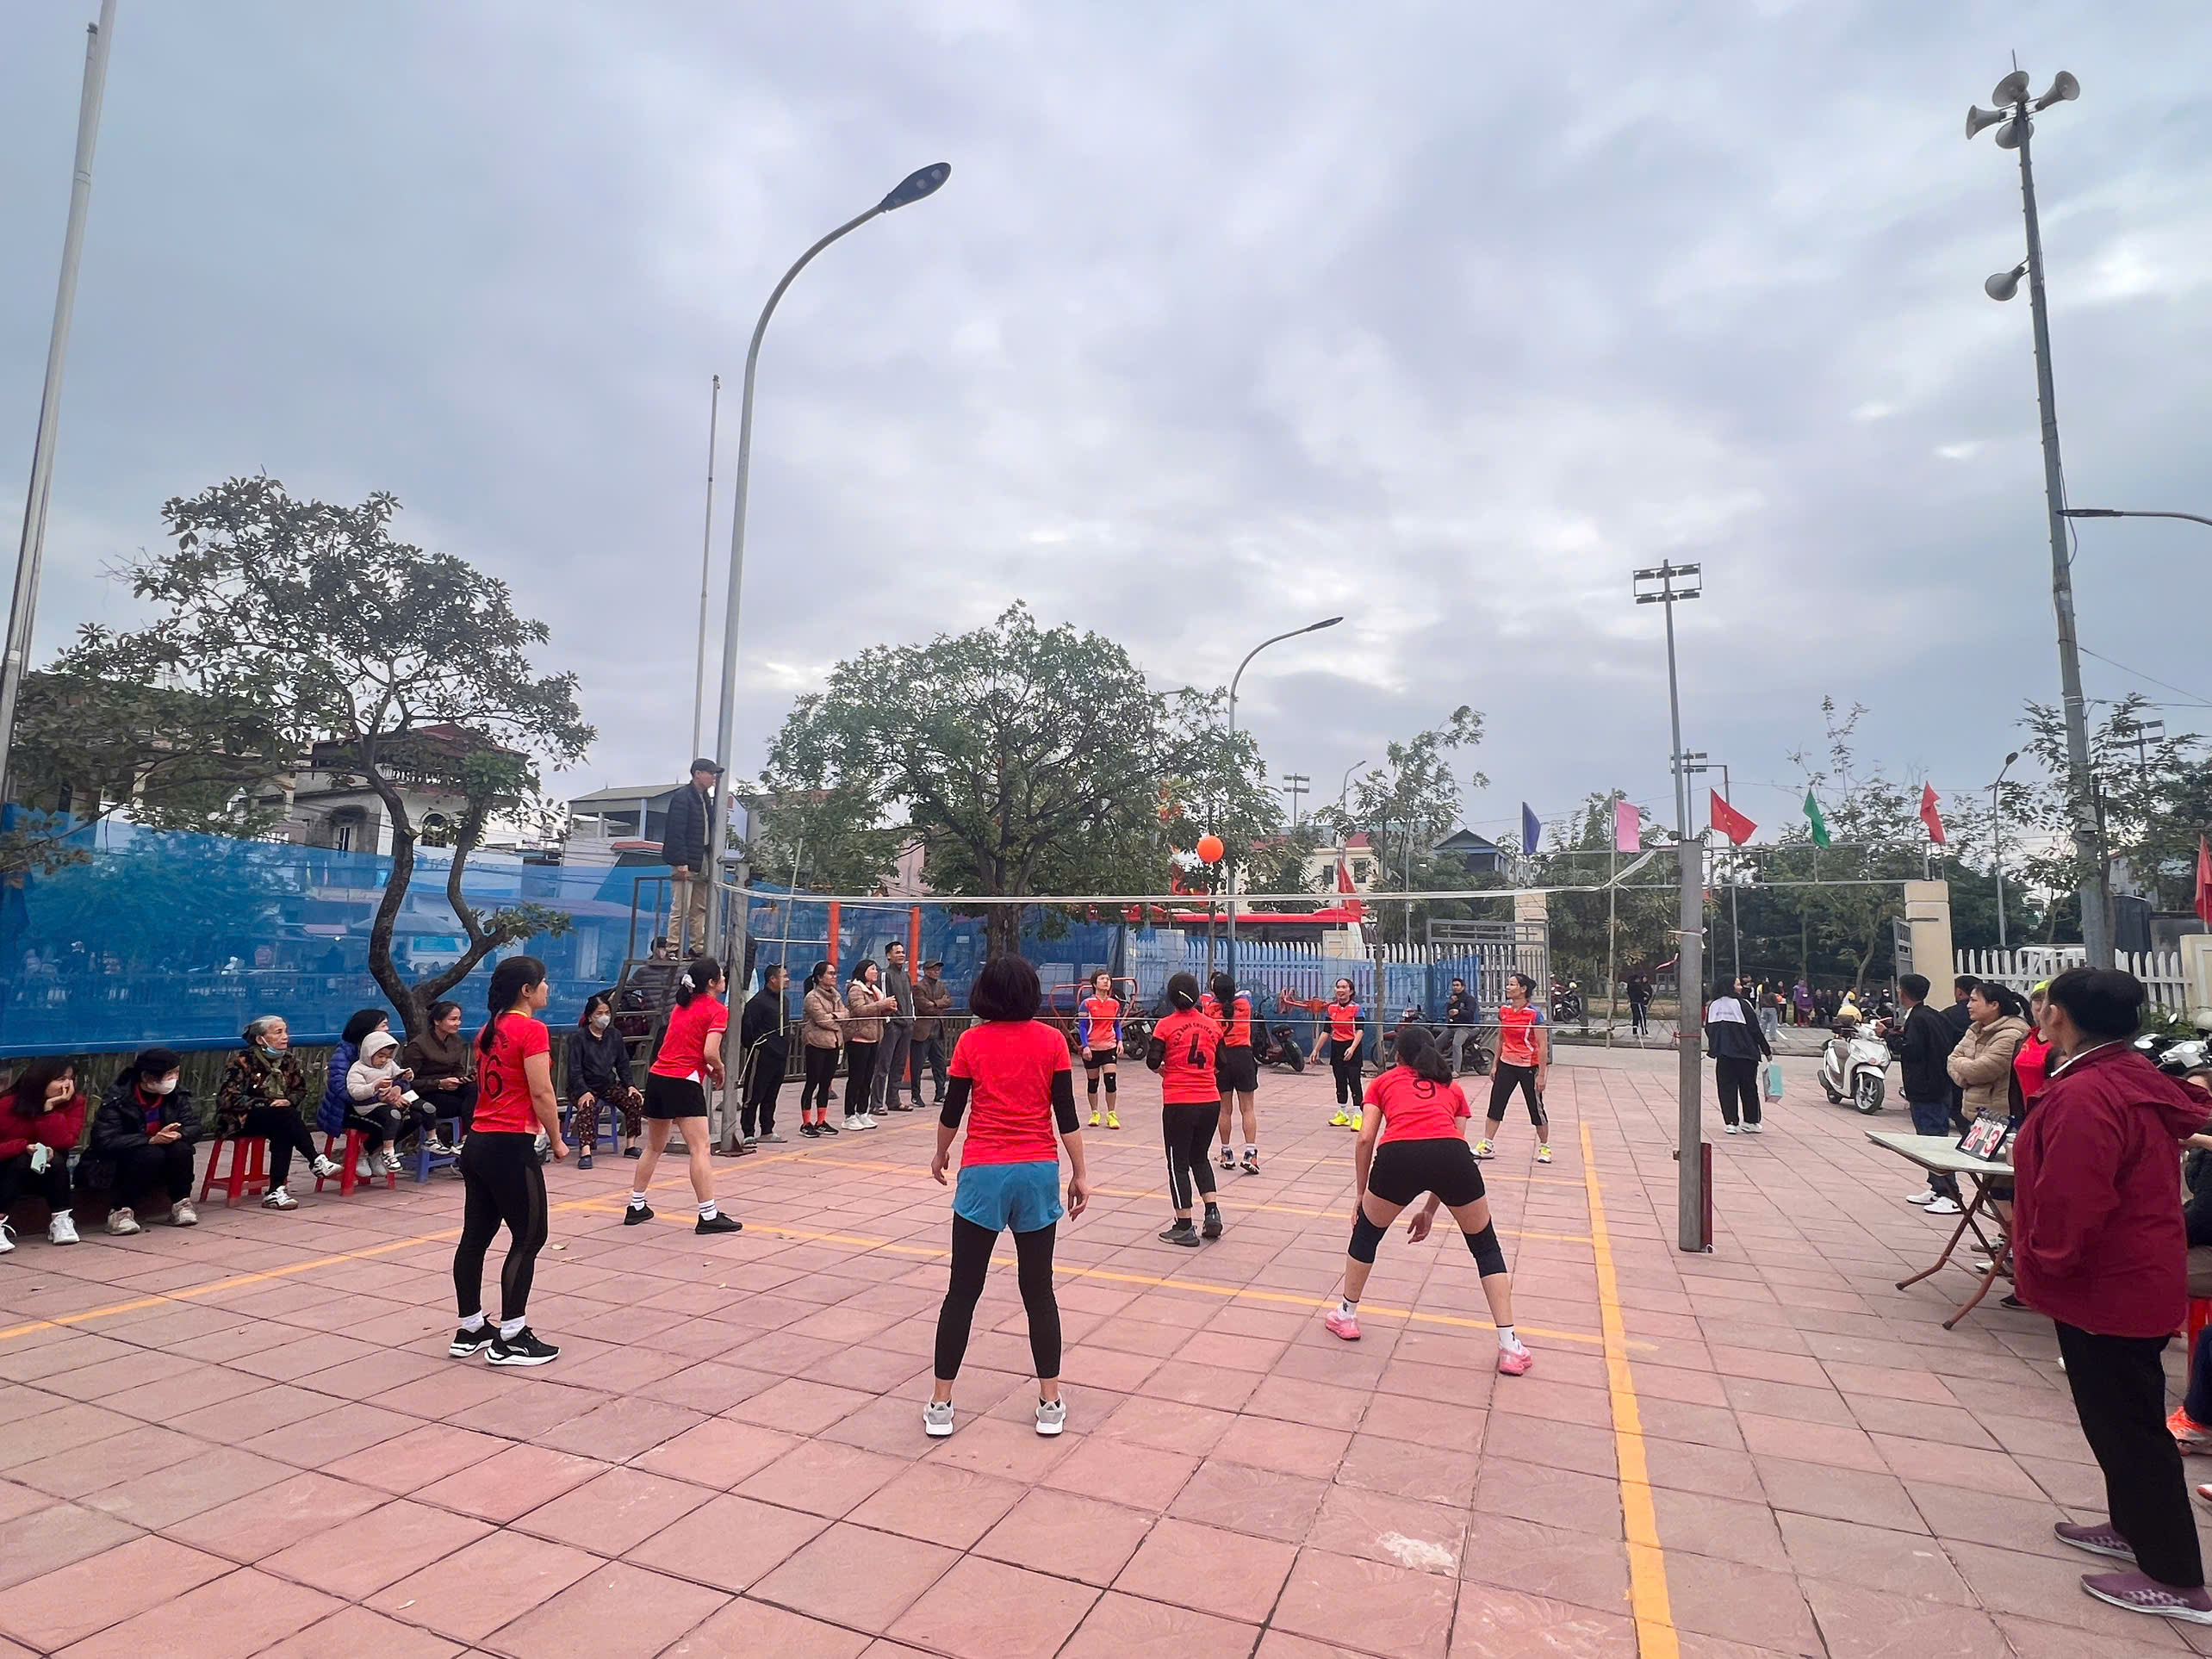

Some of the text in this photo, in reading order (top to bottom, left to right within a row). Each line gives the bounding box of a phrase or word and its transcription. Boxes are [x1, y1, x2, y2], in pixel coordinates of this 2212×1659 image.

[1188, 1033, 1207, 1070] 4
[476, 1054, 503, 1099] 16
[1413, 1078, 1436, 1099] 9
[1984, 1129, 2001, 1154] 3
